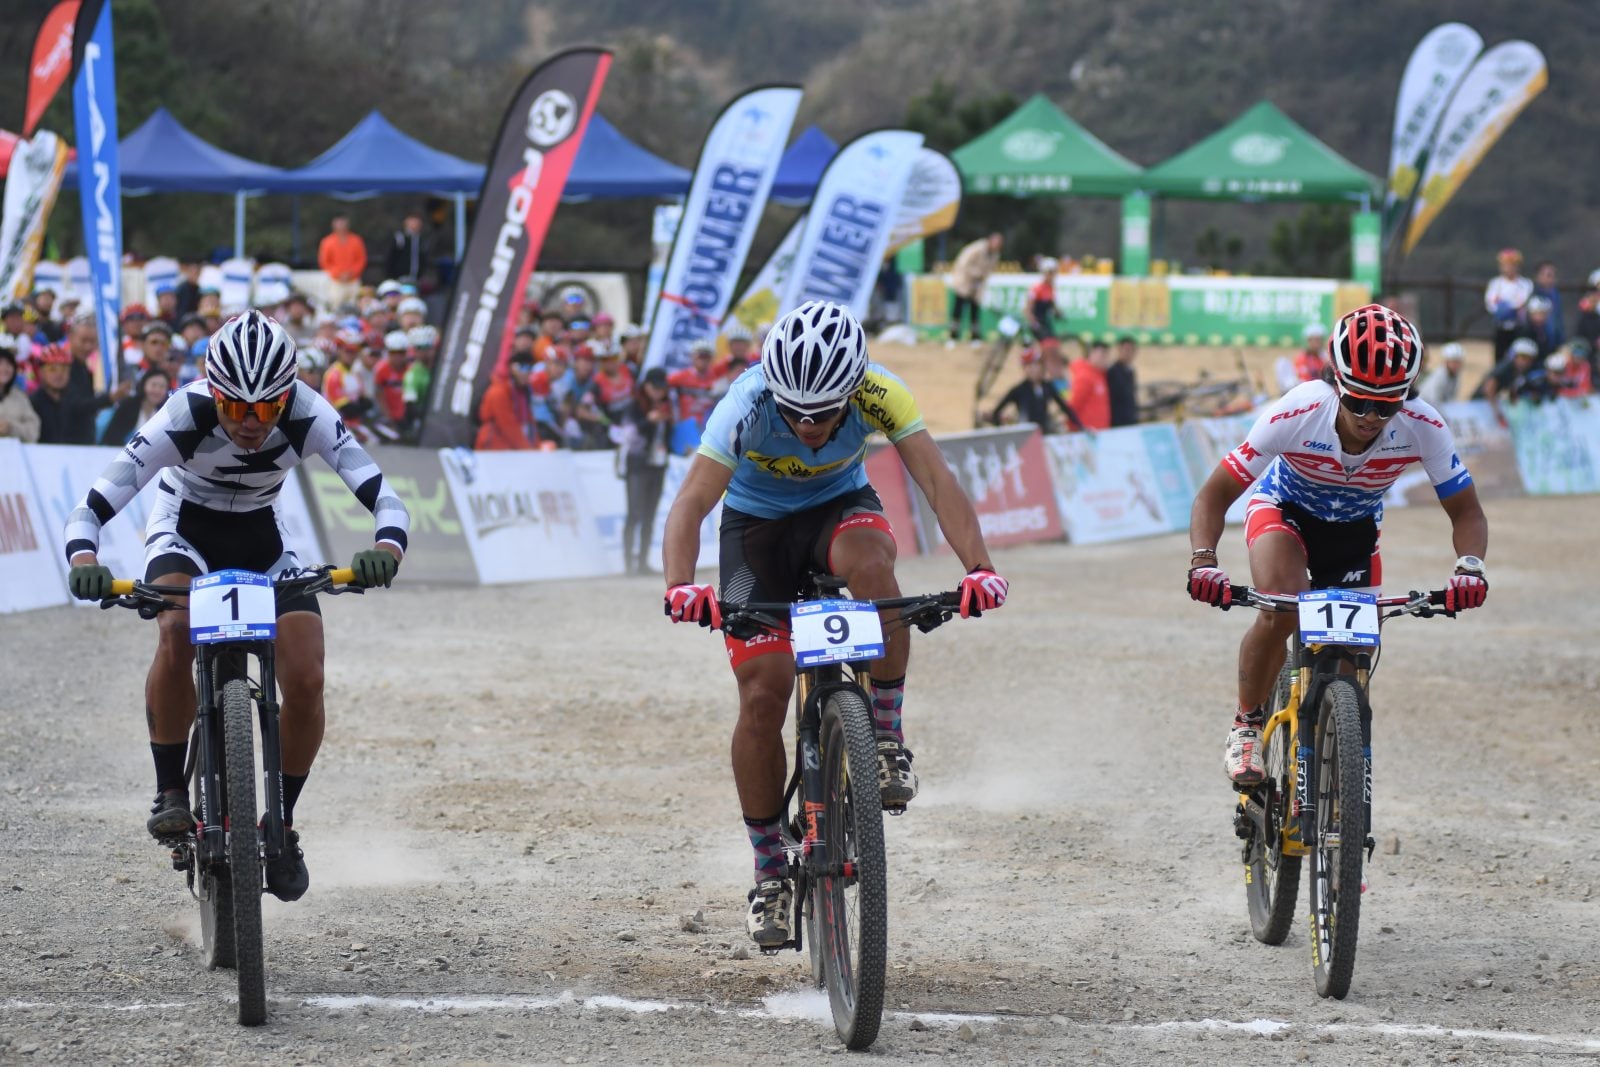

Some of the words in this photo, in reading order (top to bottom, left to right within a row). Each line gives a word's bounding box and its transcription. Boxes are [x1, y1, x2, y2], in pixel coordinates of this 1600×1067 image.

[803, 195, 882, 302] WER
[451, 147, 545, 417] FOURIERS
[839, 375, 855, 394] uvex
[1269, 401, 1321, 425] FUJI
[1302, 440, 1335, 452] OVAL
[221, 587, 240, 621] 1
[1317, 602, 1362, 630] 17
[823, 614, 850, 645] 9
